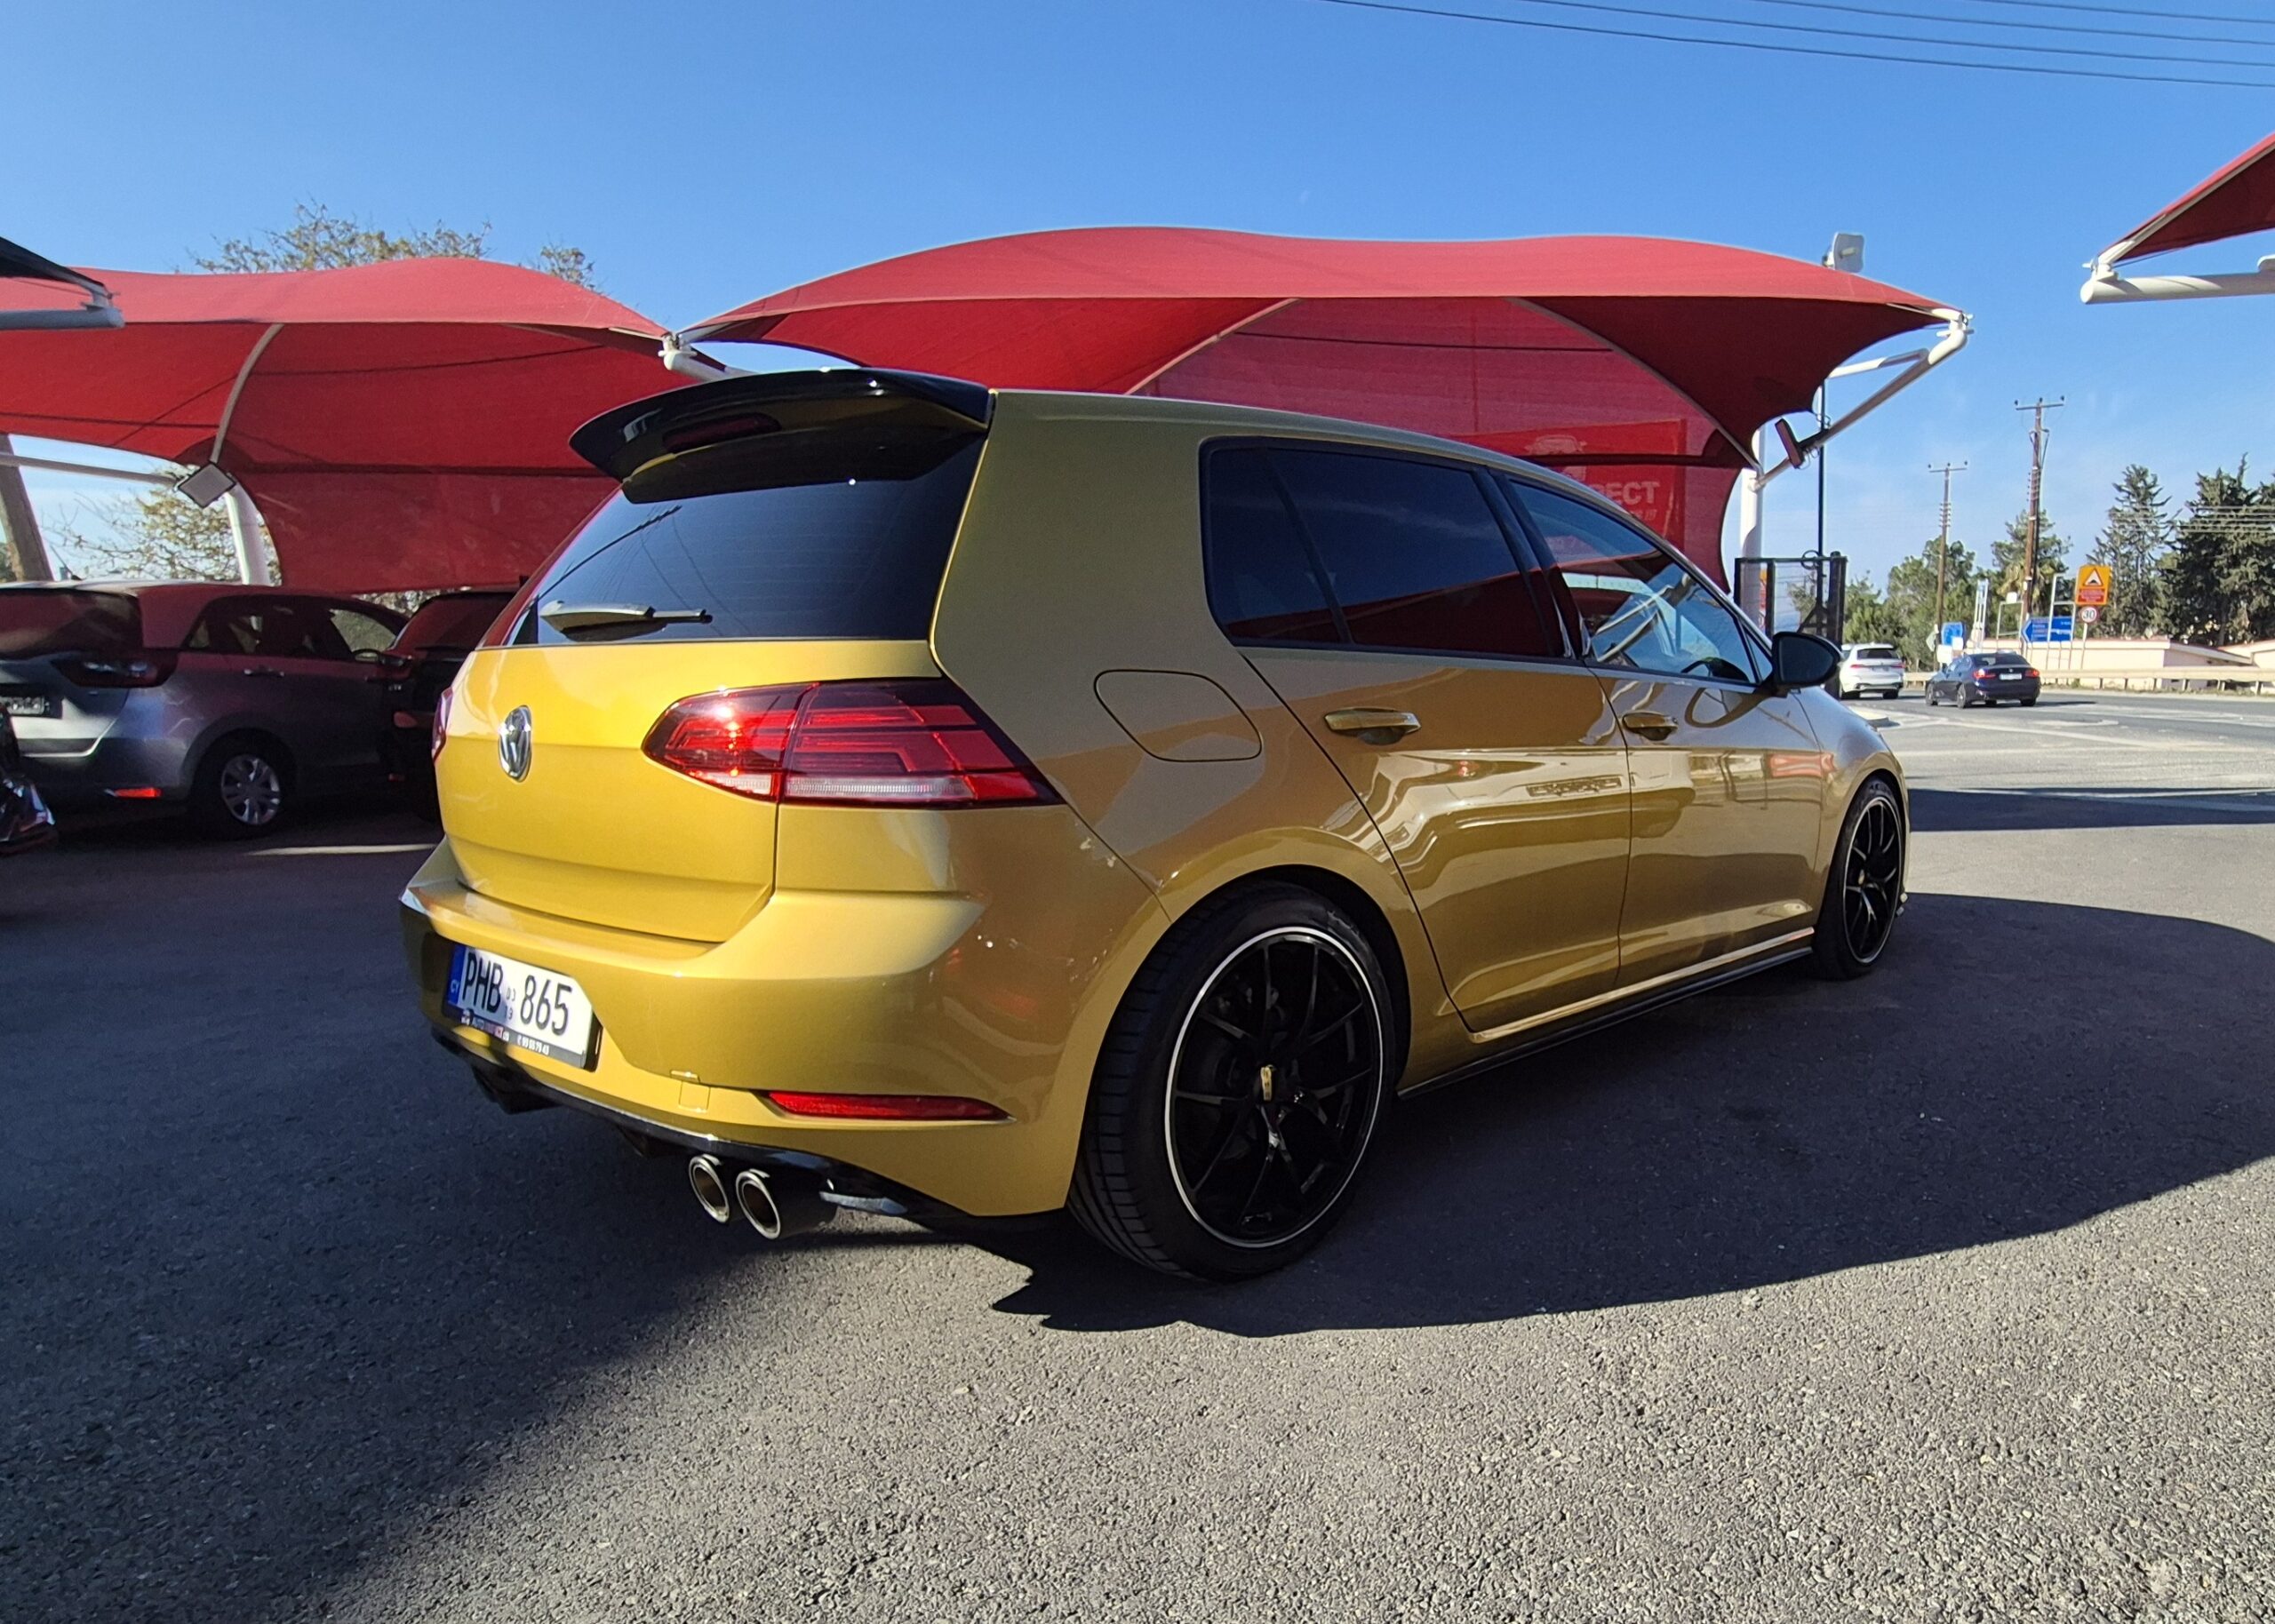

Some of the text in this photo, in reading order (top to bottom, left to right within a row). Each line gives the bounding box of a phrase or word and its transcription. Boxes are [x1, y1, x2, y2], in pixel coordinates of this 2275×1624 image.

[2083, 609, 2095, 619] 30
[462, 952, 503, 1013] PHB
[520, 975, 572, 1036] 865
